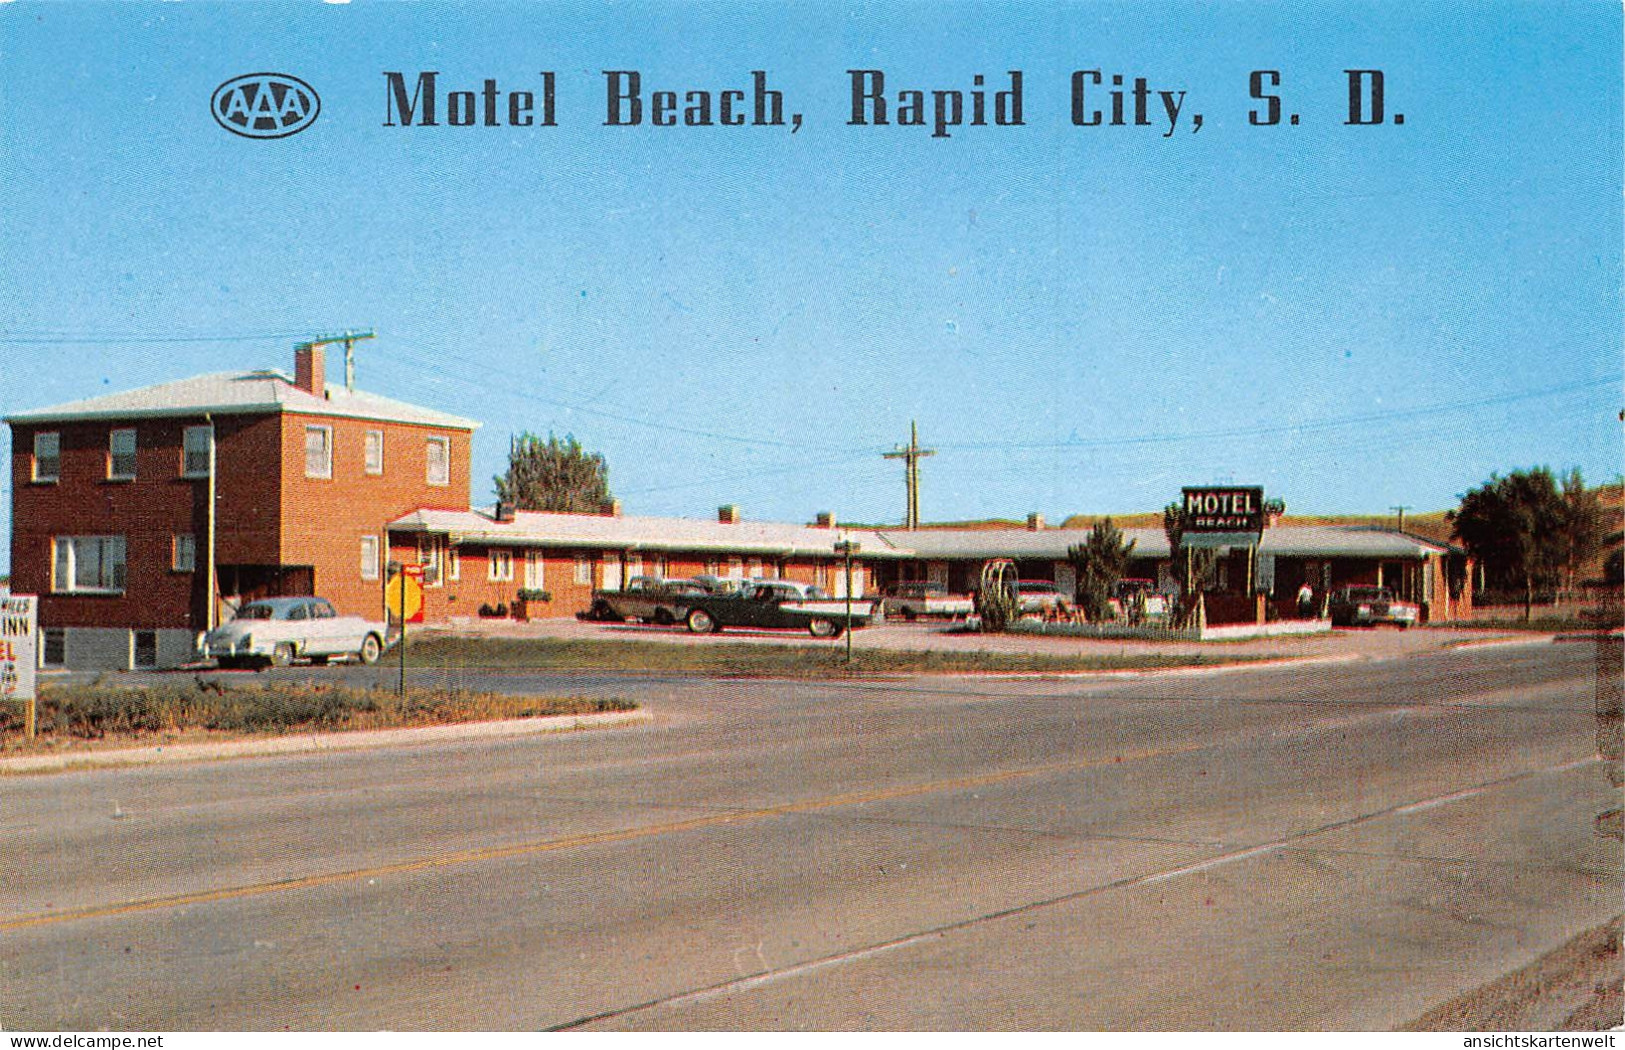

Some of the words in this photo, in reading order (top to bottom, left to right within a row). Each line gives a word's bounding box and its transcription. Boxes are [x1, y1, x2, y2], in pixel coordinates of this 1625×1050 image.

[1187, 491, 1257, 515] MOTEL
[1195, 515, 1250, 528] BEACH
[2, 616, 30, 636] INN
